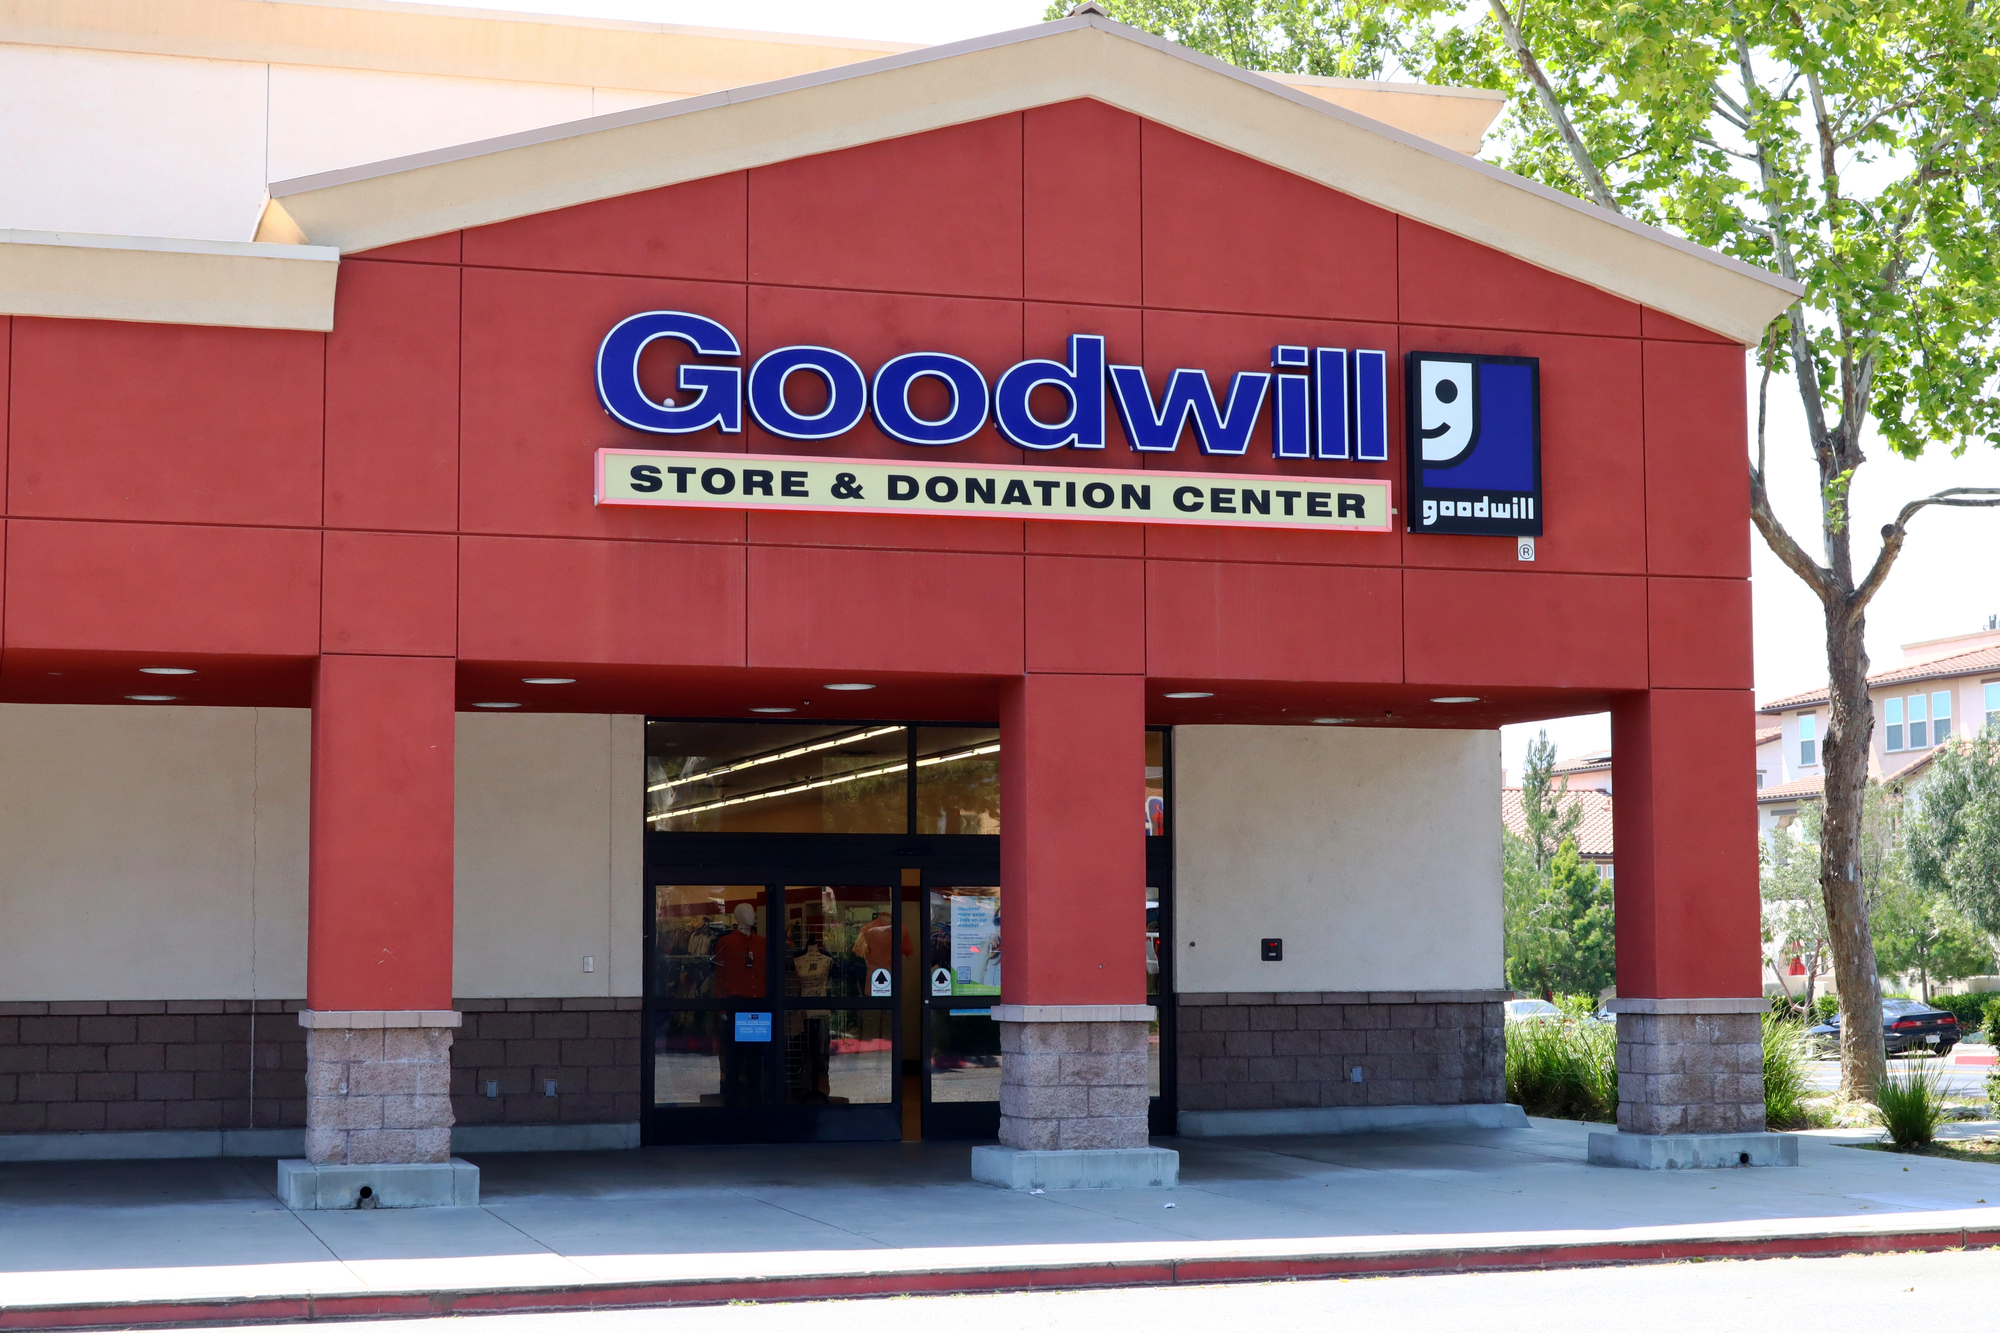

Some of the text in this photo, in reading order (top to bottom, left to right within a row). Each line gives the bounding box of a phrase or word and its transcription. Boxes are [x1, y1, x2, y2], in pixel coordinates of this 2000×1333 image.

[595, 310, 1389, 462] Goodwill
[629, 464, 1366, 519] STORE & DONATION CENTER
[1422, 496, 1535, 526] goodwill
